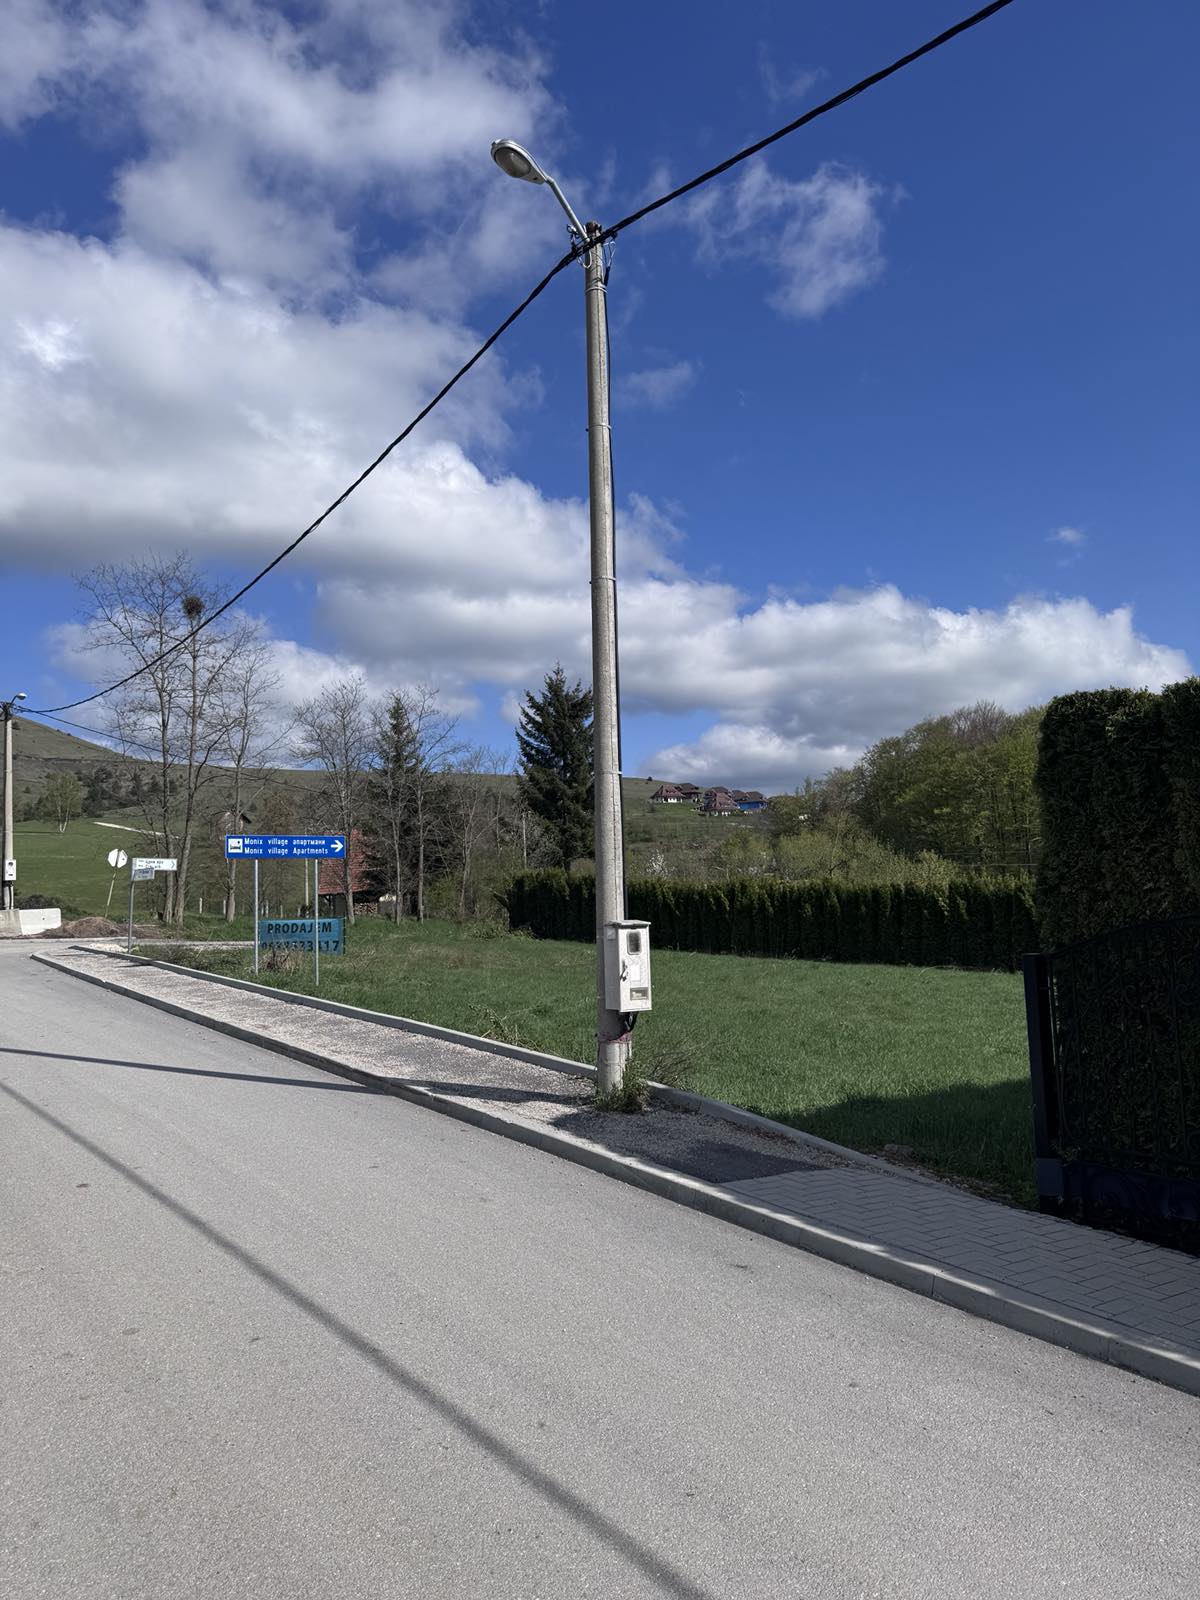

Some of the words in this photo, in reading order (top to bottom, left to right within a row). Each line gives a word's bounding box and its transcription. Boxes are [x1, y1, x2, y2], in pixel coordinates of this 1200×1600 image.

[268, 838, 288, 846] village
[268, 847, 288, 856] village
[292, 847, 328, 855] Apartments
